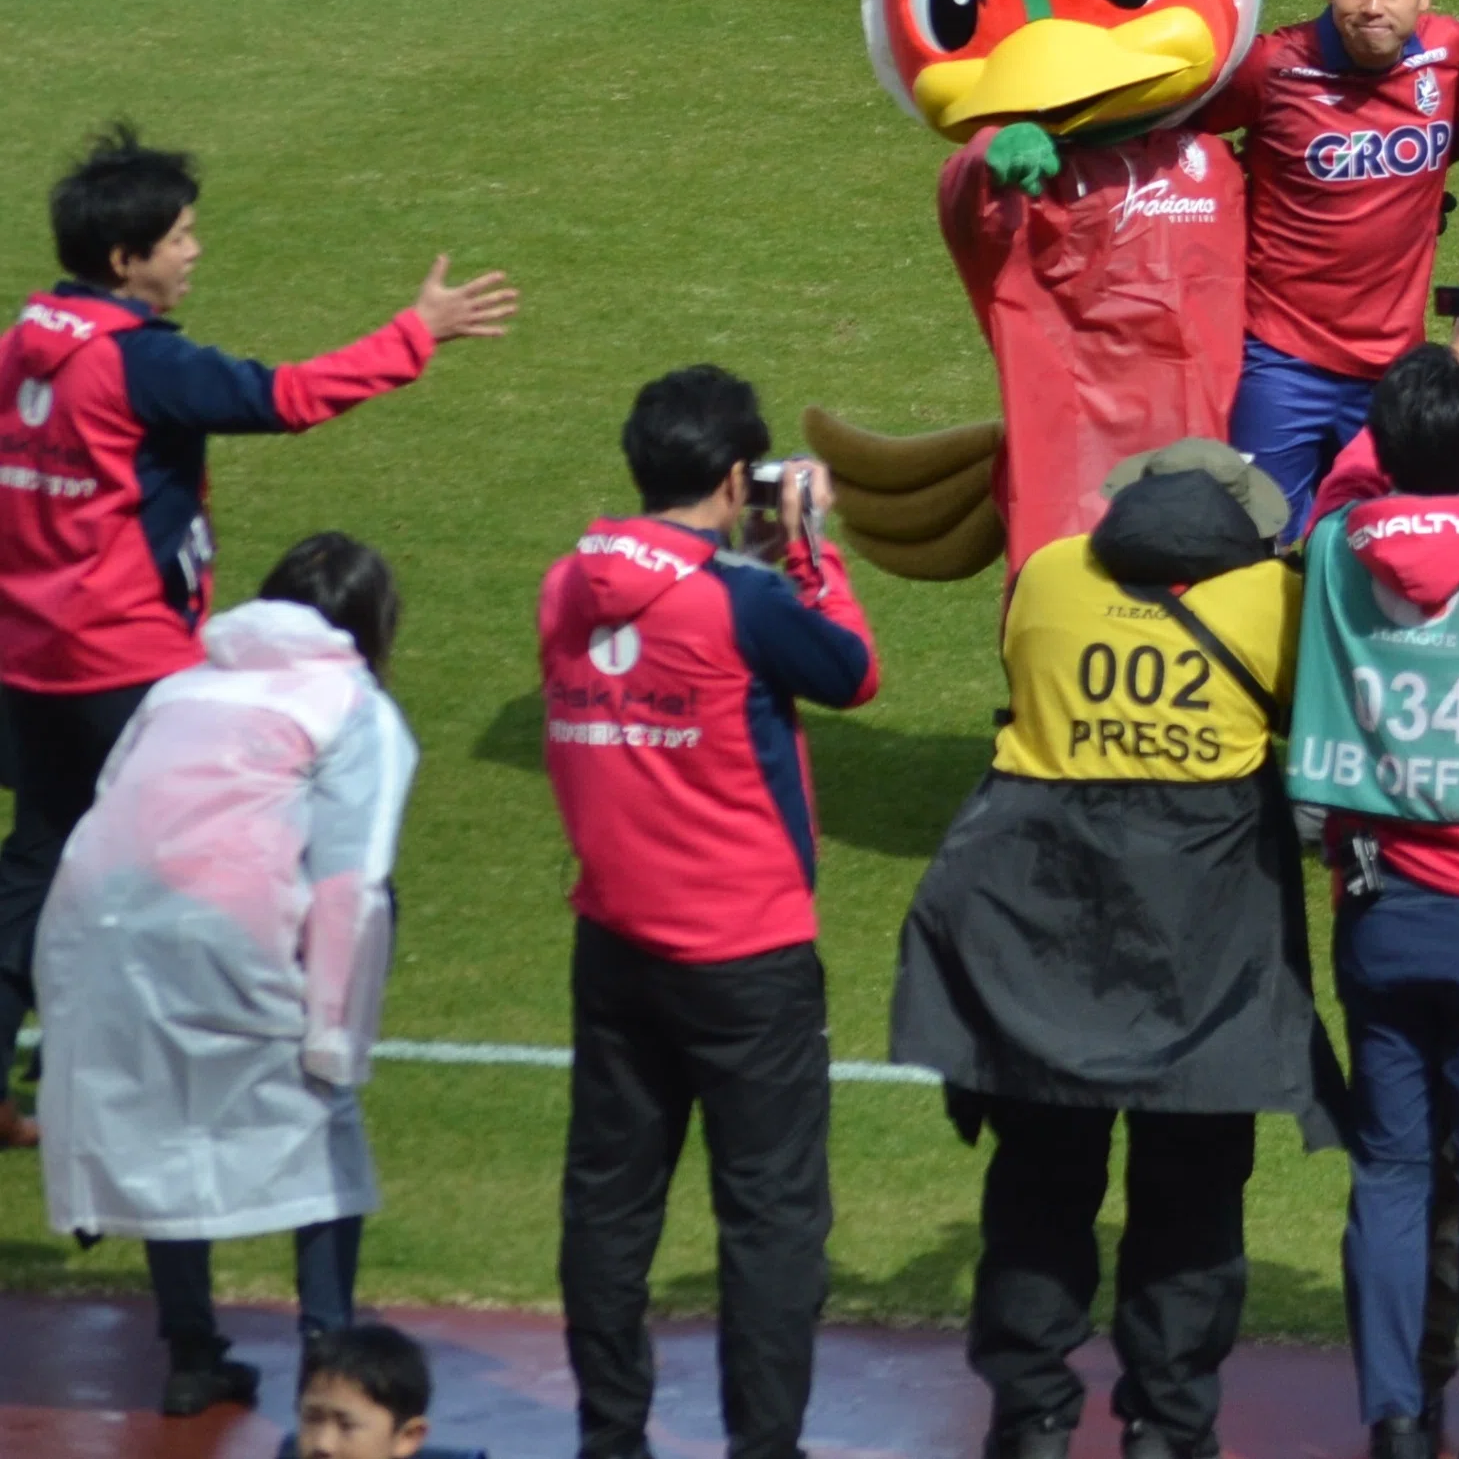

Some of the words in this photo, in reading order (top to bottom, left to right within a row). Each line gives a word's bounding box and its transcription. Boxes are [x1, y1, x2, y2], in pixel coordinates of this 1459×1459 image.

[1304, 120, 1453, 182] GROP
[1104, 604, 1168, 621] J.LEAG
[1079, 641, 1211, 712] 002
[1068, 718, 1222, 764] PRESS
[1287, 736, 1366, 788] UB
